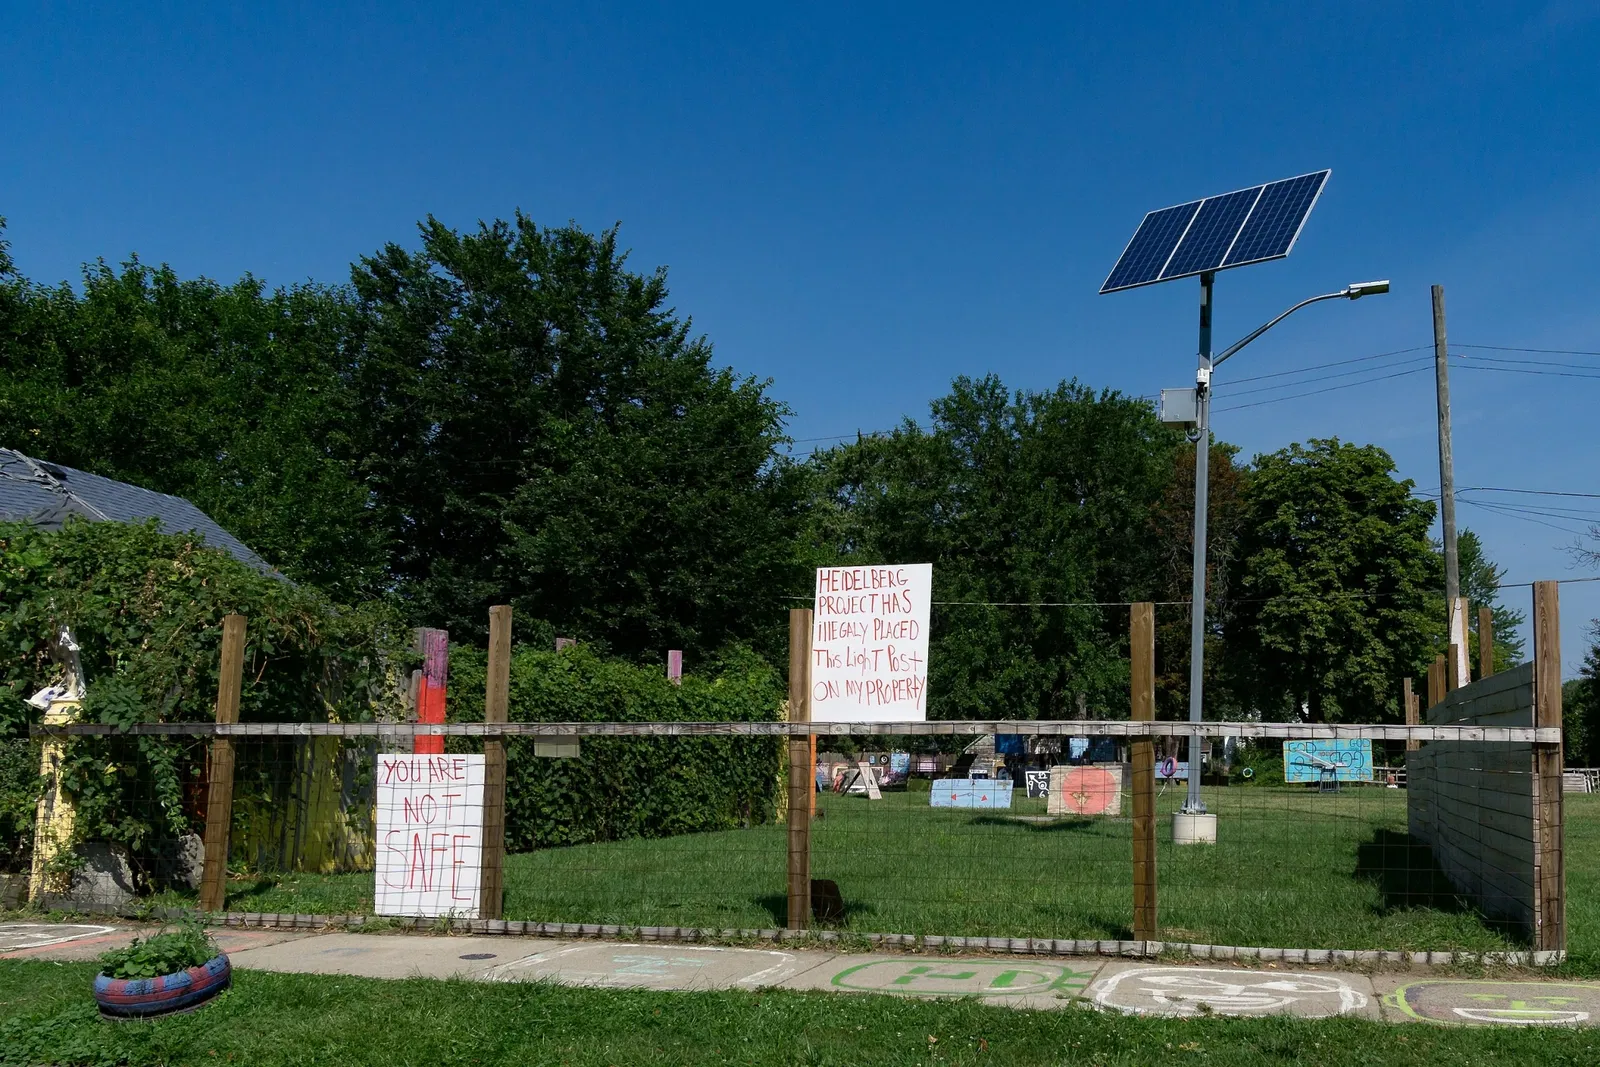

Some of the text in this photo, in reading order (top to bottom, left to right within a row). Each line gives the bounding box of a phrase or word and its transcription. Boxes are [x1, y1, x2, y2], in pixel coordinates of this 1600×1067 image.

[881, 589, 912, 615] HAS
[873, 618, 920, 641] PLACED
[813, 649, 842, 669] This
[813, 680, 840, 702] ON
[846, 679, 863, 704] MY
[383, 757, 466, 784] YOU ARE
[404, 794, 462, 825] NOT
[382, 830, 472, 900] SAFE
